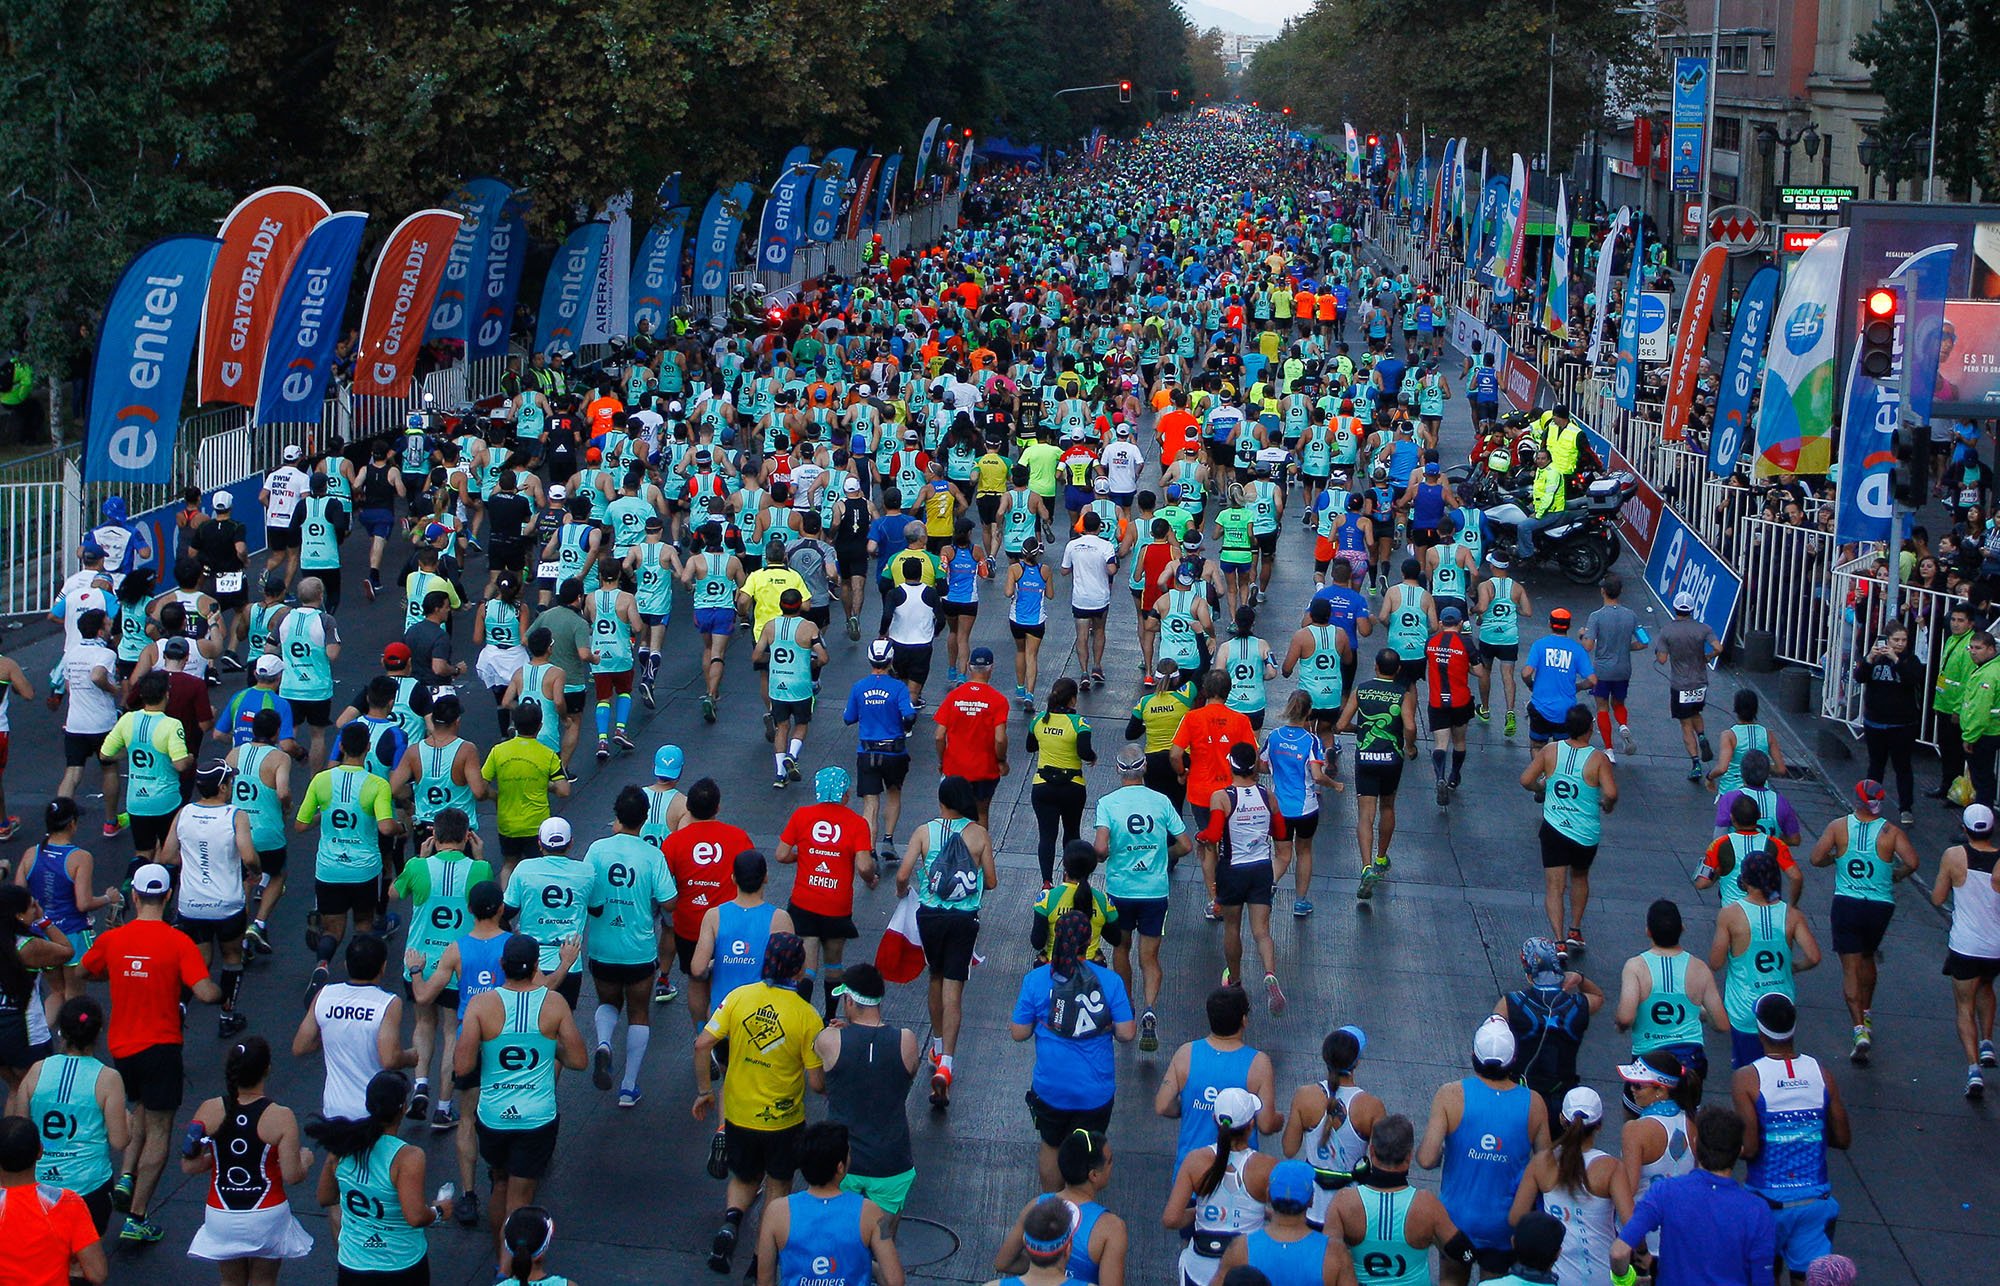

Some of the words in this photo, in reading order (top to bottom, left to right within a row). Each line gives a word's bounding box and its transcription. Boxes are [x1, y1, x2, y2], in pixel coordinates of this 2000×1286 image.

[774, 182, 796, 231] entel
[446, 200, 484, 280] entel
[487, 222, 512, 298] entel
[230, 216, 283, 352] GATORADE
[383, 240, 430, 356] GATORADE
[558, 246, 590, 318] entel
[297, 266, 332, 348] entel
[129, 274, 184, 389] entel
[1734, 299, 1764, 397] entel
[1964, 353, 1976, 364] ES
[1982, 354, 1994, 364] TU
[1150, 704, 1174, 714] MANU
[1360, 752, 1392, 761] THULE
[199, 841, 210, 884] RUNNING
[808, 874, 839, 890] REMEDY
[722, 954, 756, 966] Runners
[325, 1006, 376, 1022] JORGE
[757, 1008, 778, 1020] IRON
[1468, 1148, 1508, 1163] Runners
